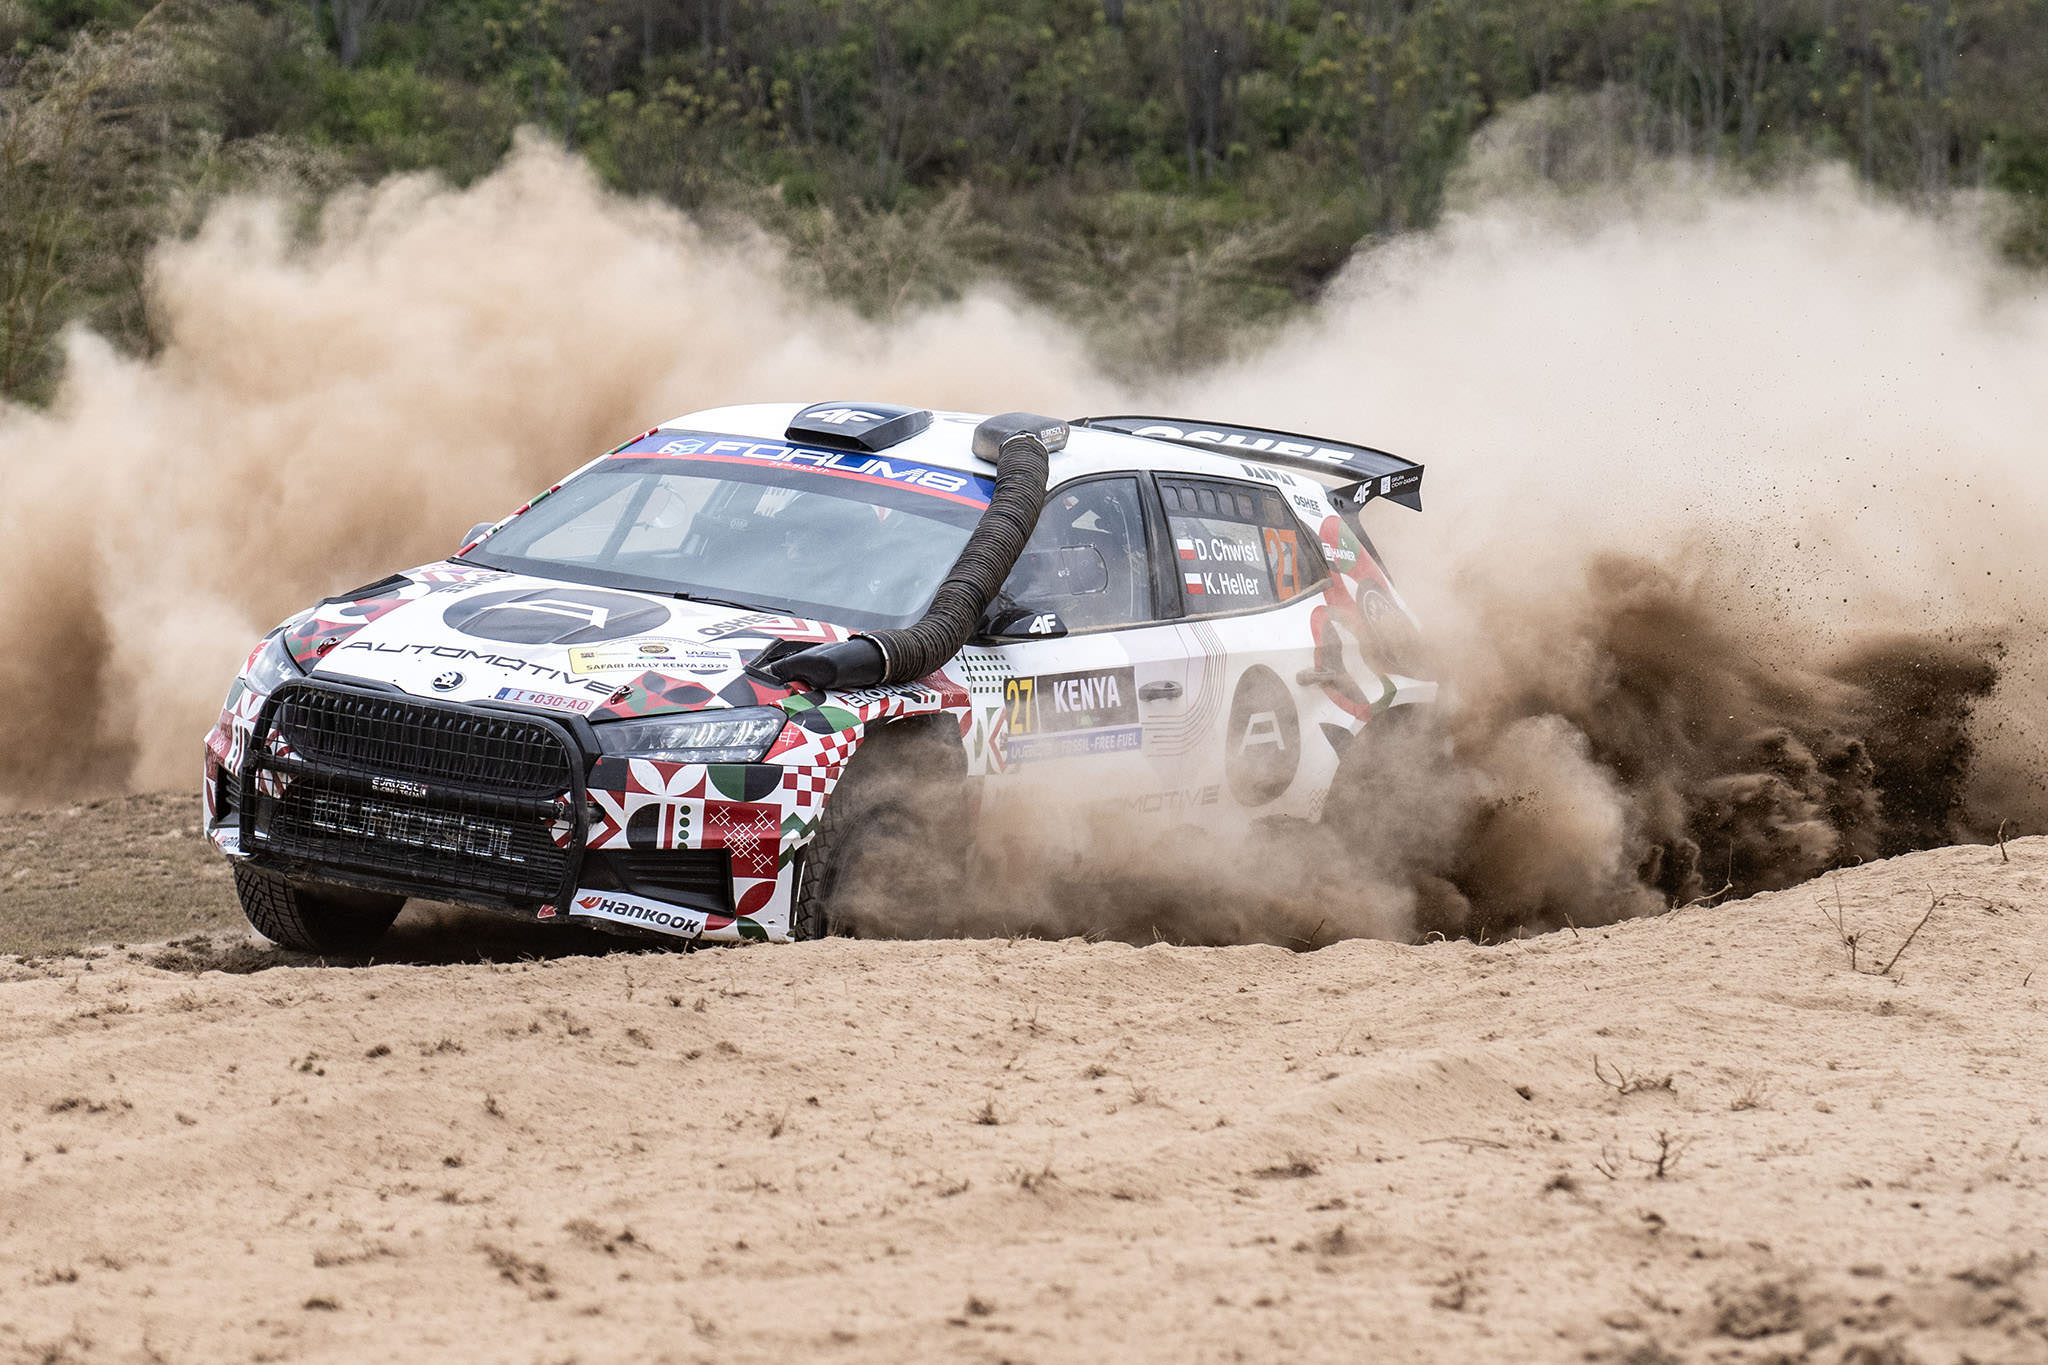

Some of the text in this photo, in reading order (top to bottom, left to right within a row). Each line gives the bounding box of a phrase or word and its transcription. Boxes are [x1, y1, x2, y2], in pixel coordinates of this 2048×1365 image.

[805, 408, 885, 425] 4F
[704, 440, 968, 492] FORUM8
[1293, 494, 1320, 512] OSHEE
[1354, 480, 1372, 504] 4F
[1264, 528, 1299, 600] 27
[697, 612, 779, 636] OSHEE
[1028, 613, 1056, 635] 4F
[341, 641, 615, 696] AUTOMOTIVE
[586, 663, 624, 671] SAFARI
[1053, 675, 1122, 714] KENYA
[1006, 679, 1033, 735] 27
[1117, 732, 1138, 747] FUEL
